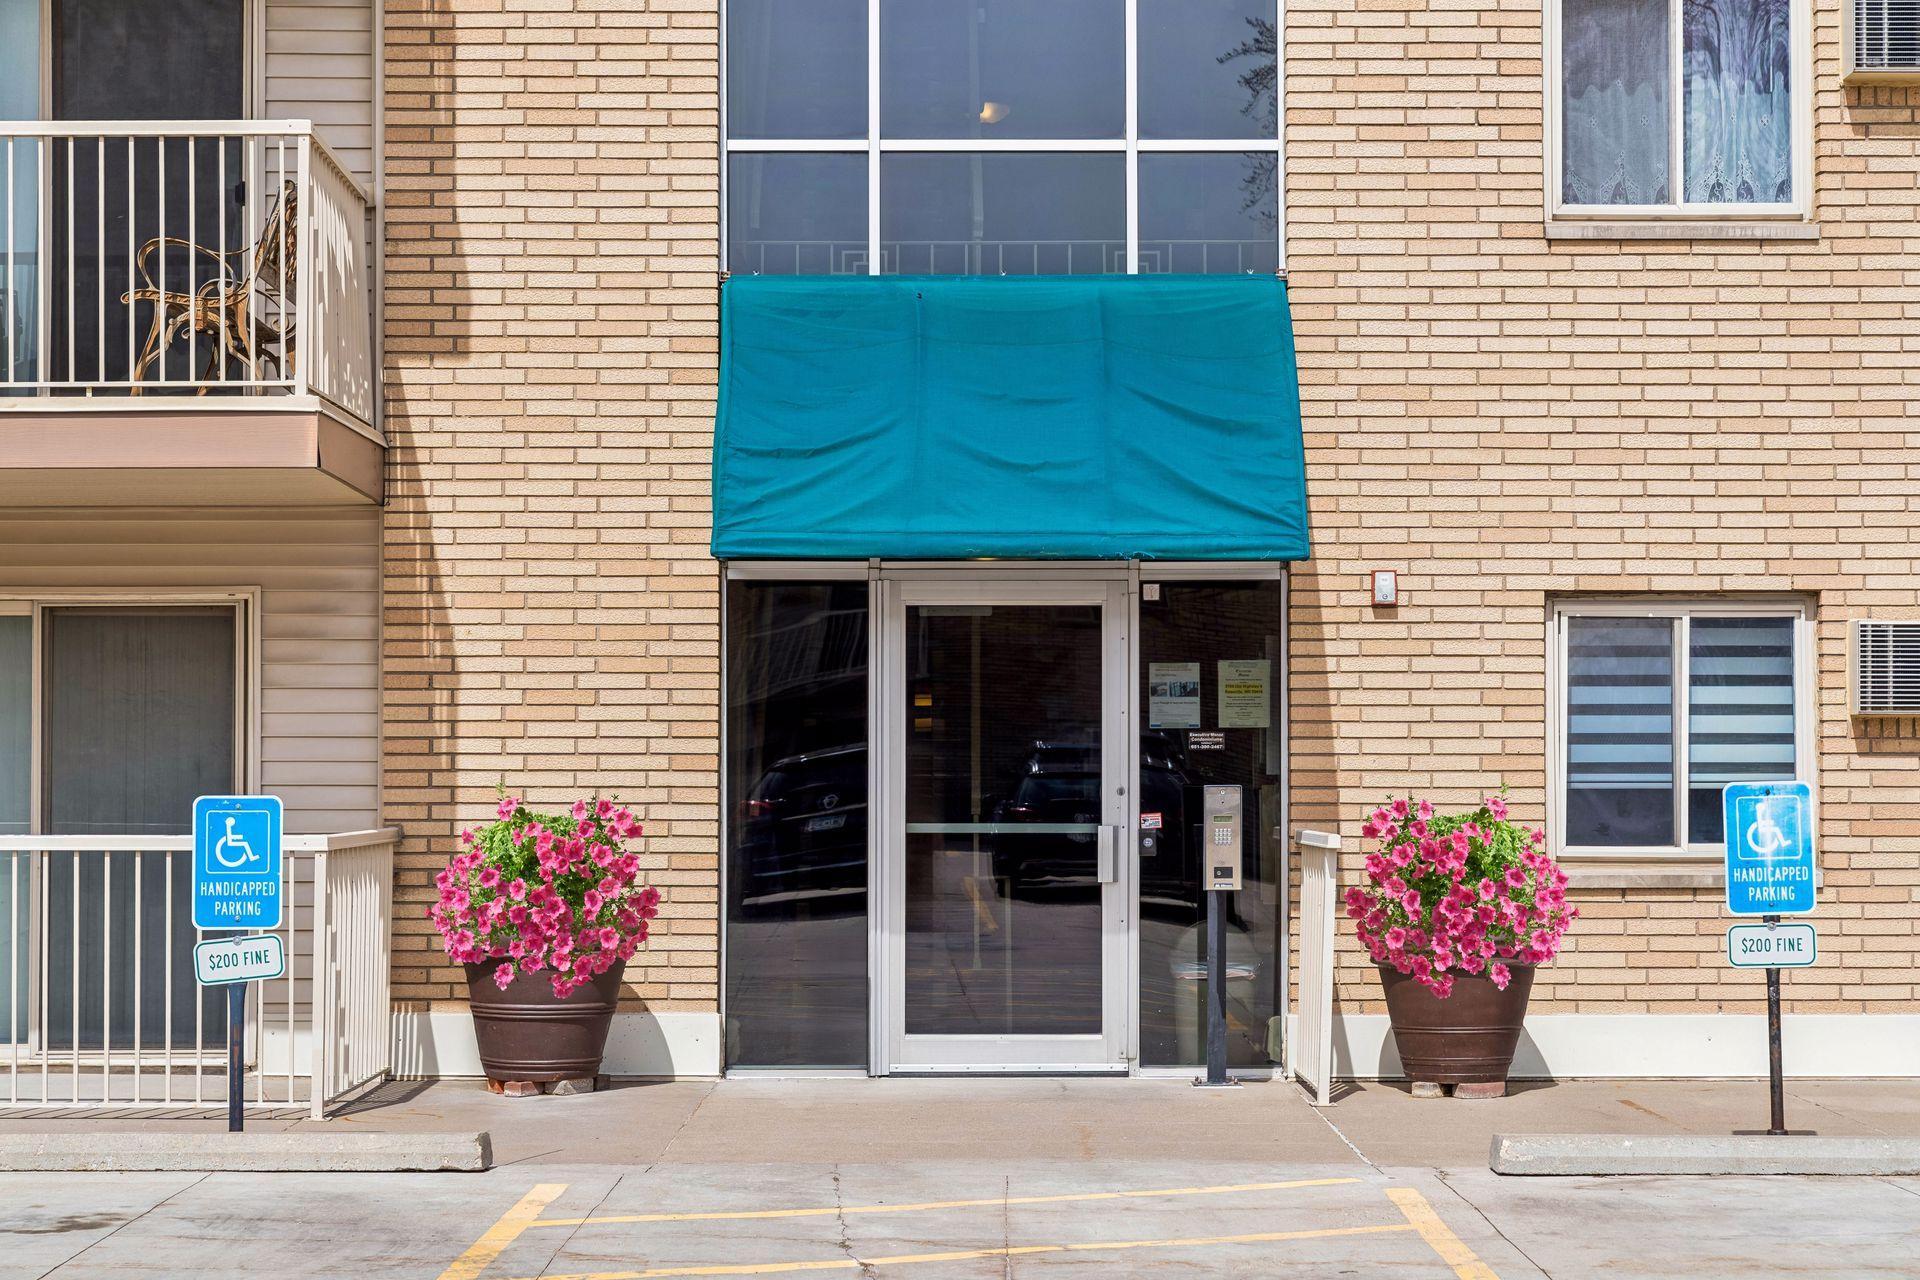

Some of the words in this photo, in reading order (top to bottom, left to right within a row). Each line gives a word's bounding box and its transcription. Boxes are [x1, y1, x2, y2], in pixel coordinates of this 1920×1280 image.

[1734, 866, 1809, 882] HANDICAPPED
[200, 881, 276, 896] HANDICAPPED
[1748, 886, 1795, 901] PARKING
[214, 901, 261, 916] PARKING
[1741, 938, 1771, 954] $200
[1776, 937, 1803, 952] FINE
[209, 952, 239, 971] $200
[243, 949, 271, 966] FINE
